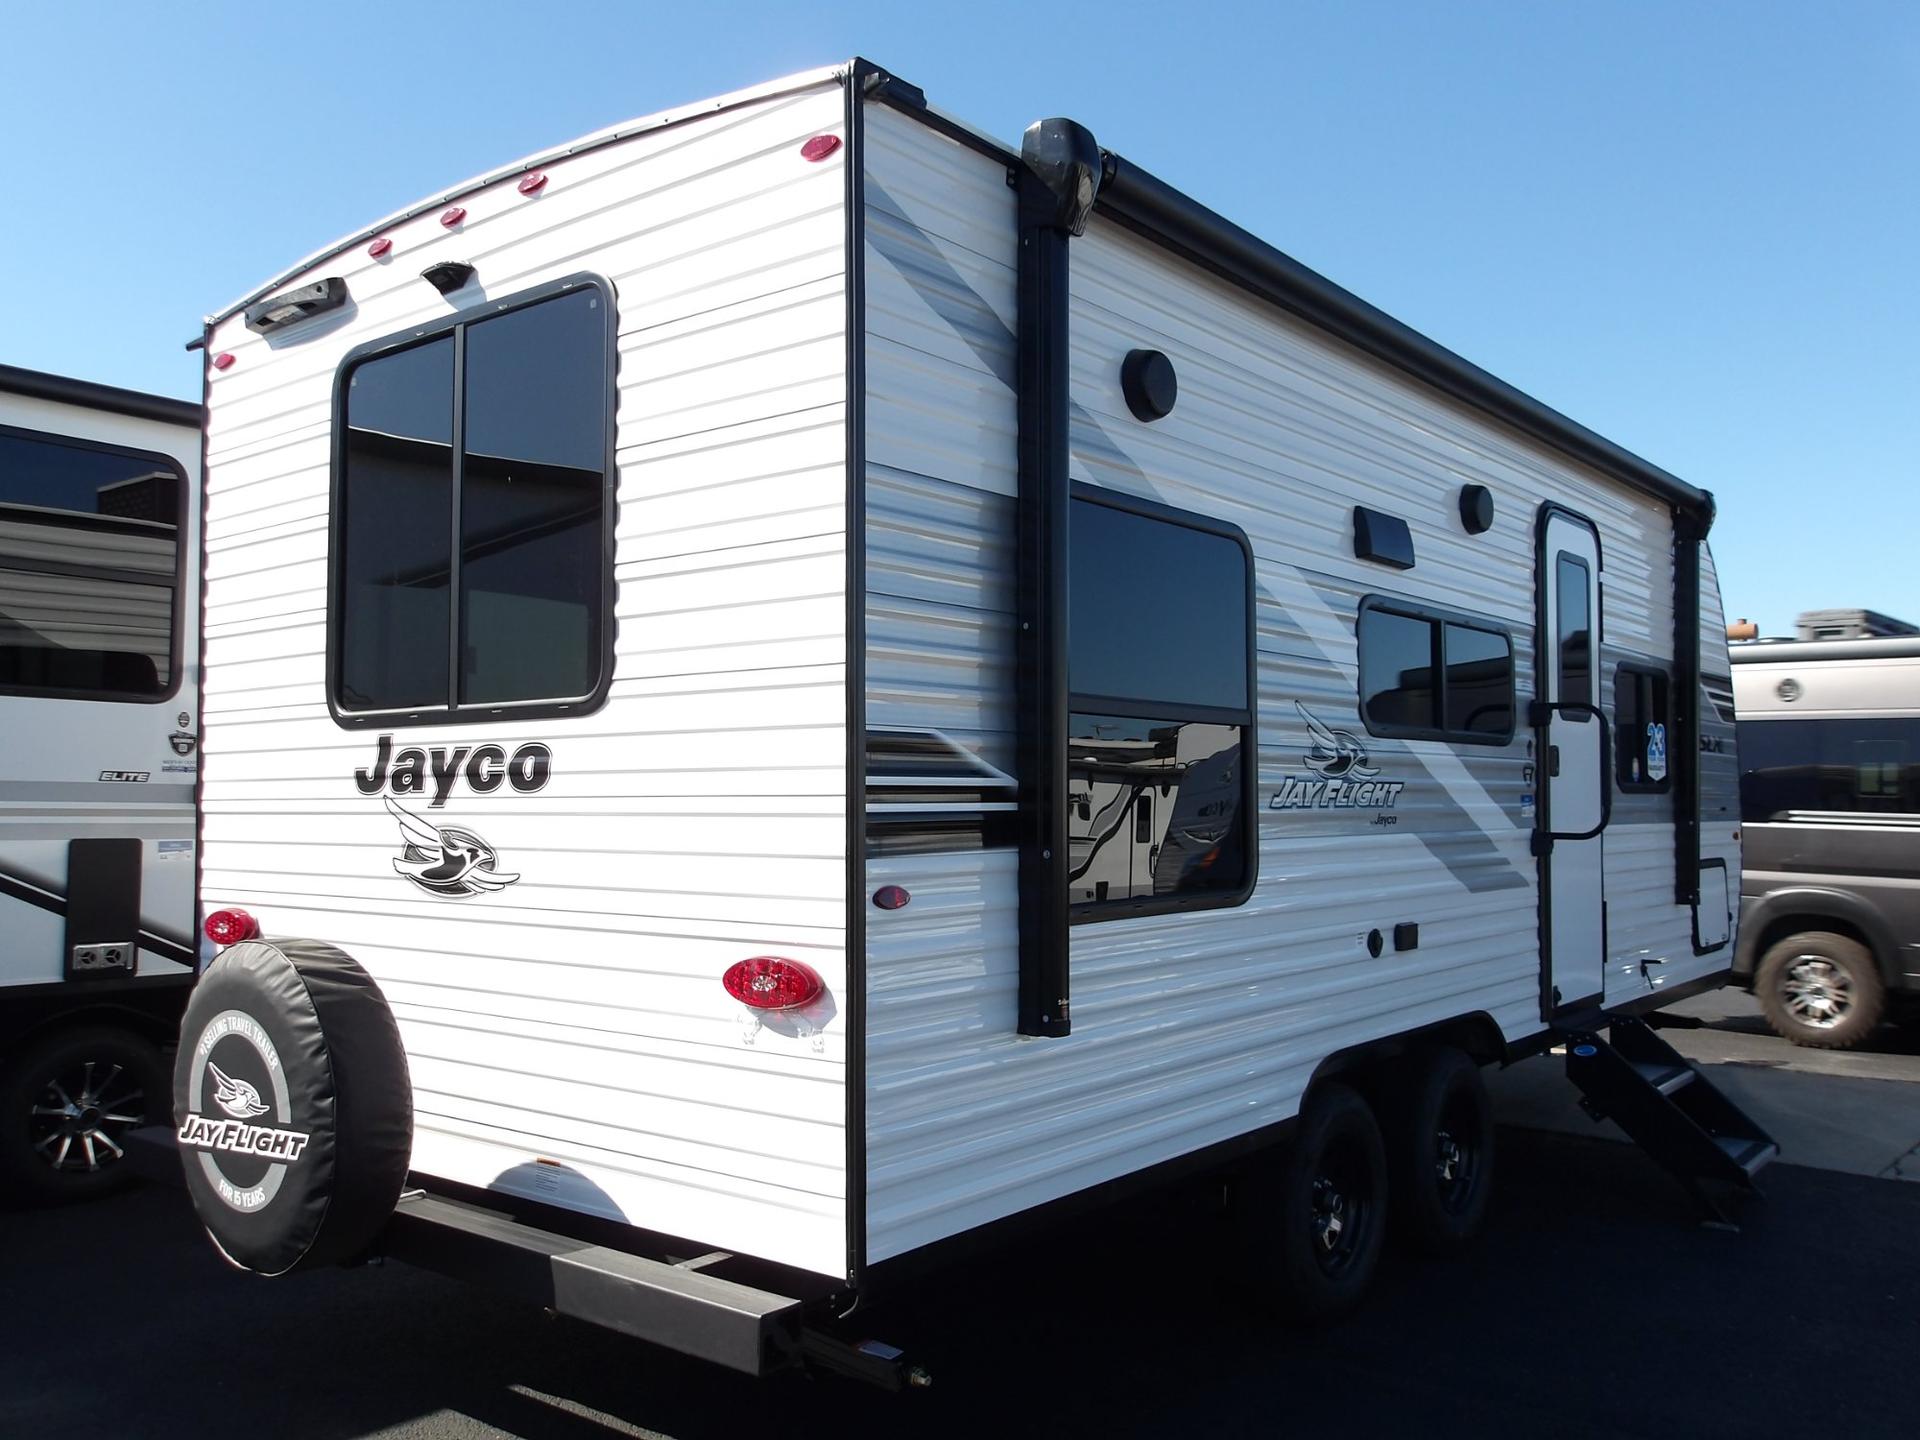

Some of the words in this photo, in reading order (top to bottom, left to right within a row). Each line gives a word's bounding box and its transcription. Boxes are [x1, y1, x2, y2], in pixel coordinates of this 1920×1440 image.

[99, 771, 151, 782] ELITE
[354, 733, 553, 808] Jayco
[1375, 812, 1397, 827] Jayco
[204, 1019, 228, 1049] SELLING
[227, 1016, 252, 1037] TRAVEL
[253, 1026, 278, 1070] TRAILER
[219, 1179, 233, 1202] FOR
[241, 1187, 266, 1208] YEARS
